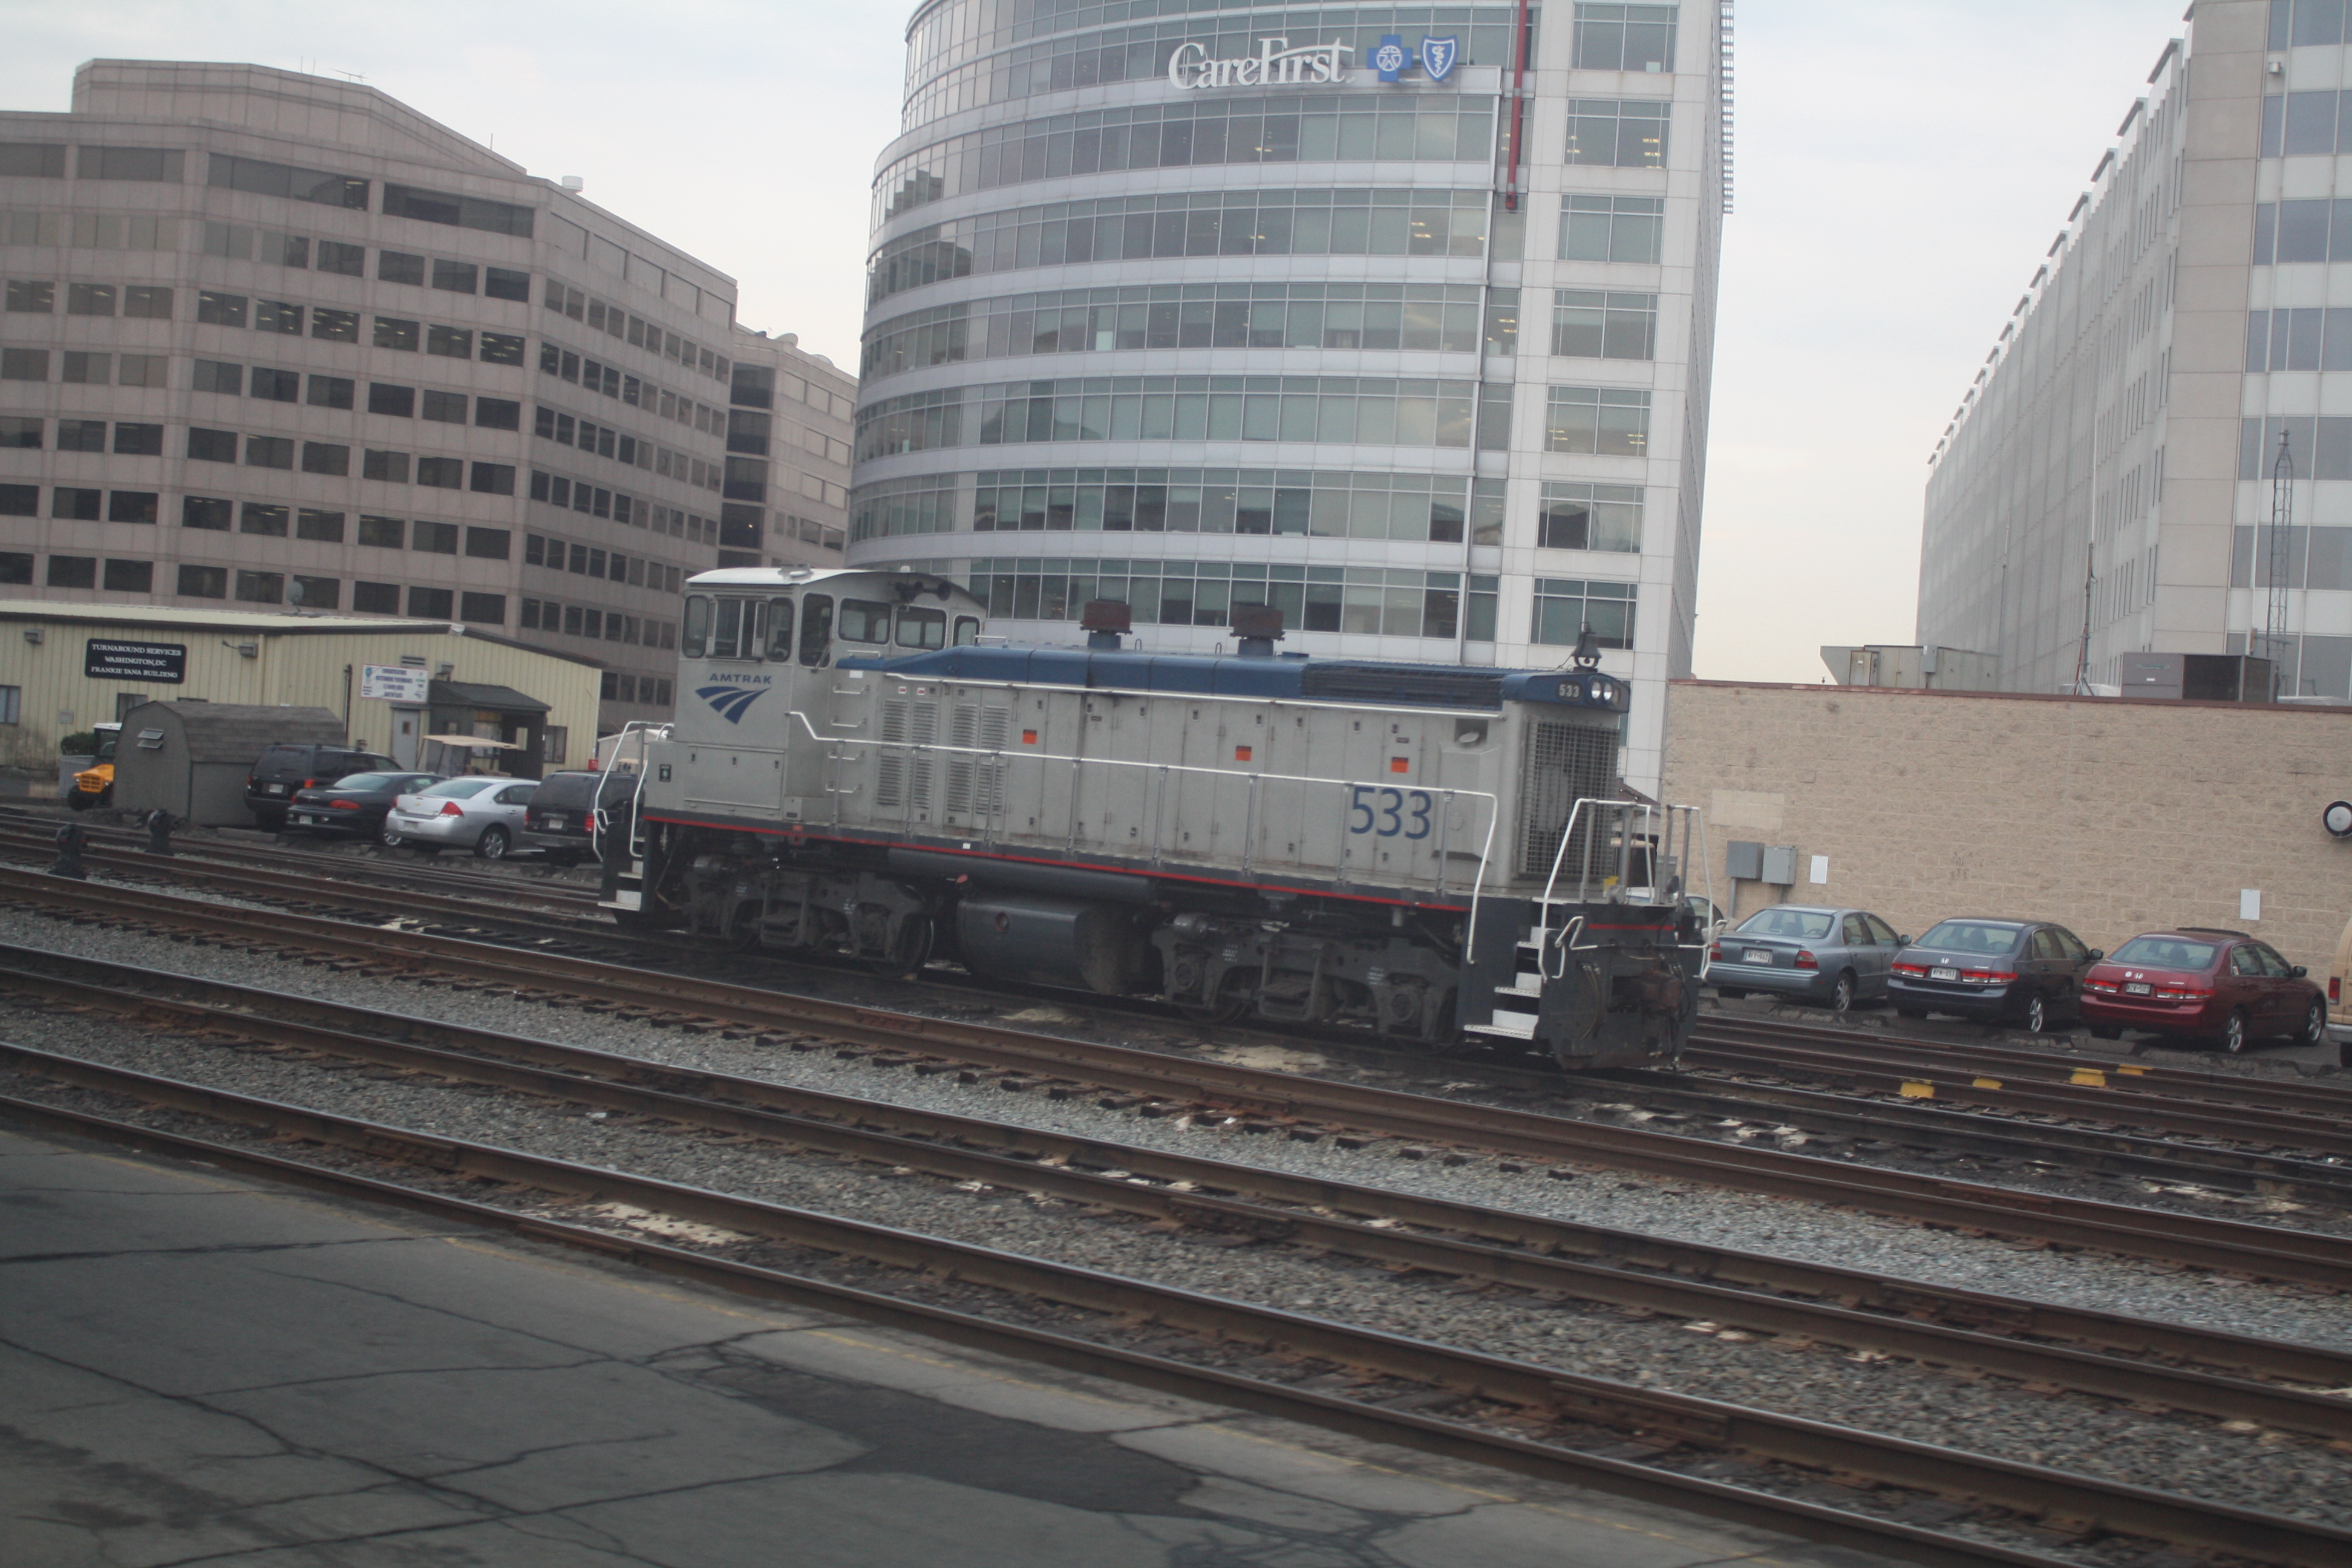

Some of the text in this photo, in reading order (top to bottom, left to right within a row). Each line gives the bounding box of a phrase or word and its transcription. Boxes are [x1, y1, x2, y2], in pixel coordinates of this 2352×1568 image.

[1168, 37, 1355, 90] CareFirst
[92, 644, 182, 656] TURNAROUND SERVICES
[710, 673, 772, 684] AMTRAK
[1559, 684, 1580, 698] 533
[1350, 786, 1432, 840] 533
